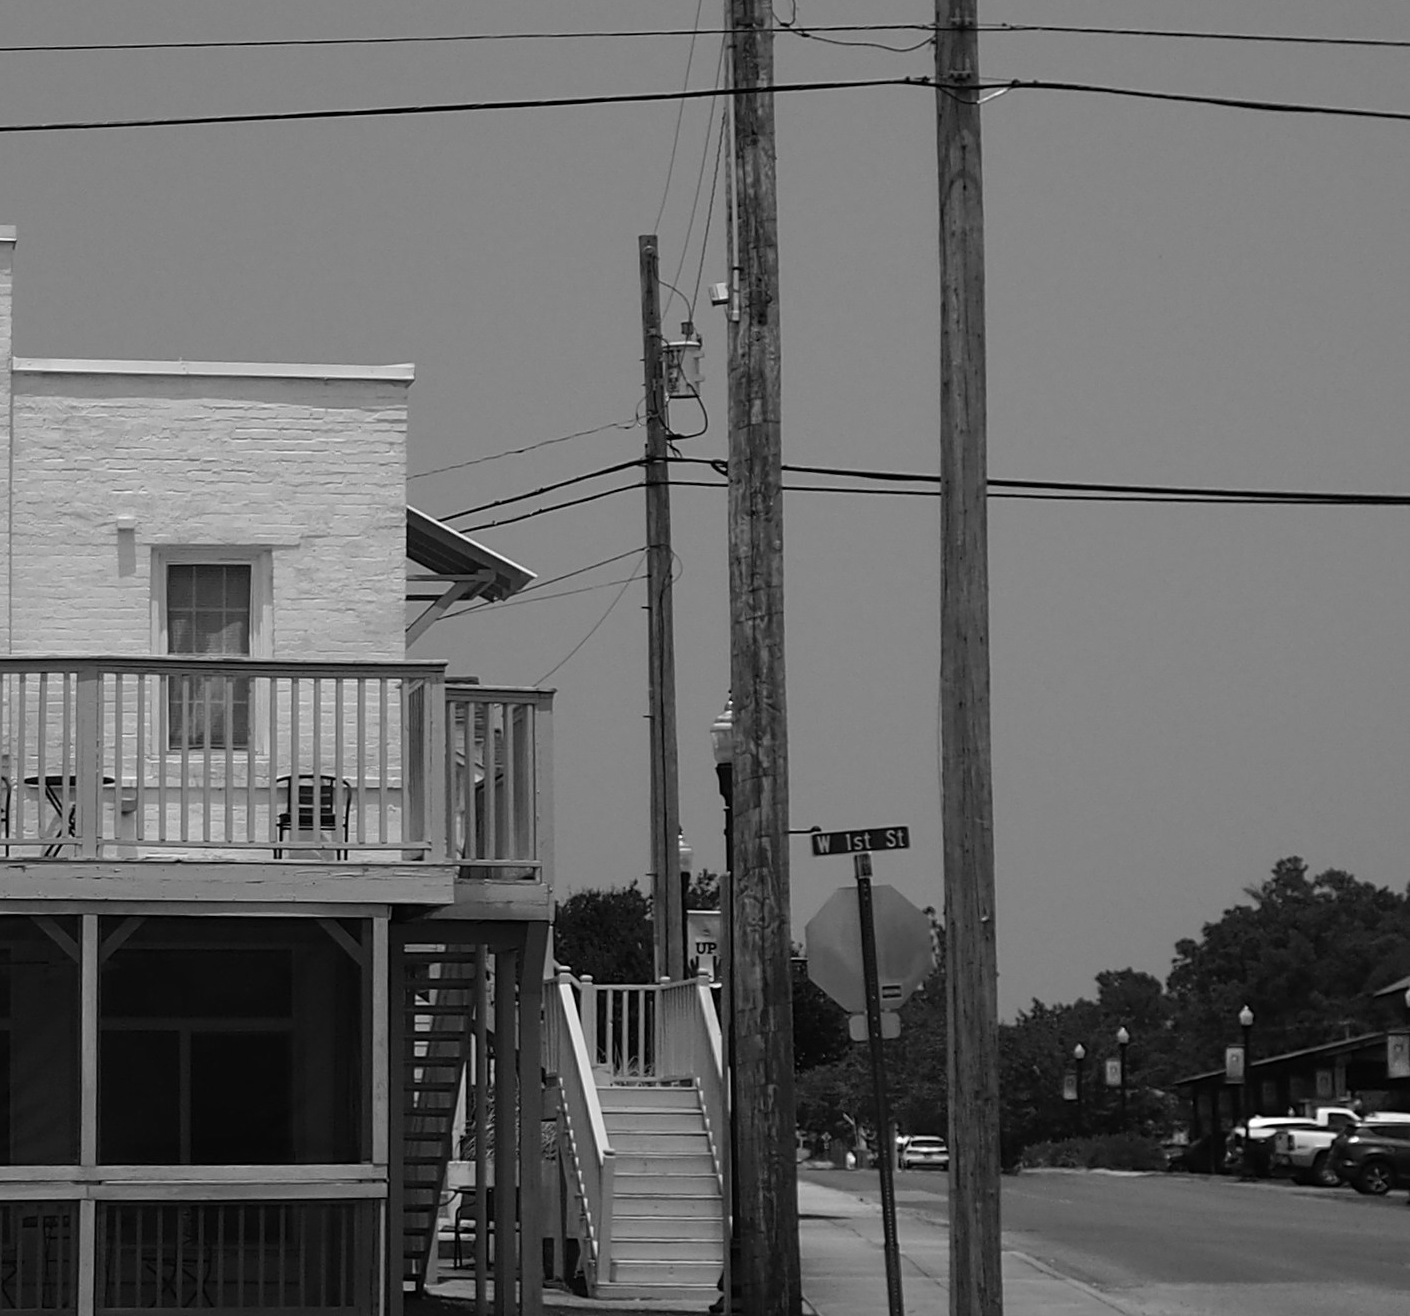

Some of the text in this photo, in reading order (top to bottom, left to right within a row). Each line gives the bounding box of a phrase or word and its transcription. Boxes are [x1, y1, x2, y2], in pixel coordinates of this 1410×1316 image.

[816, 830, 905, 854] W 1st St
[695, 942, 717, 954] UP
